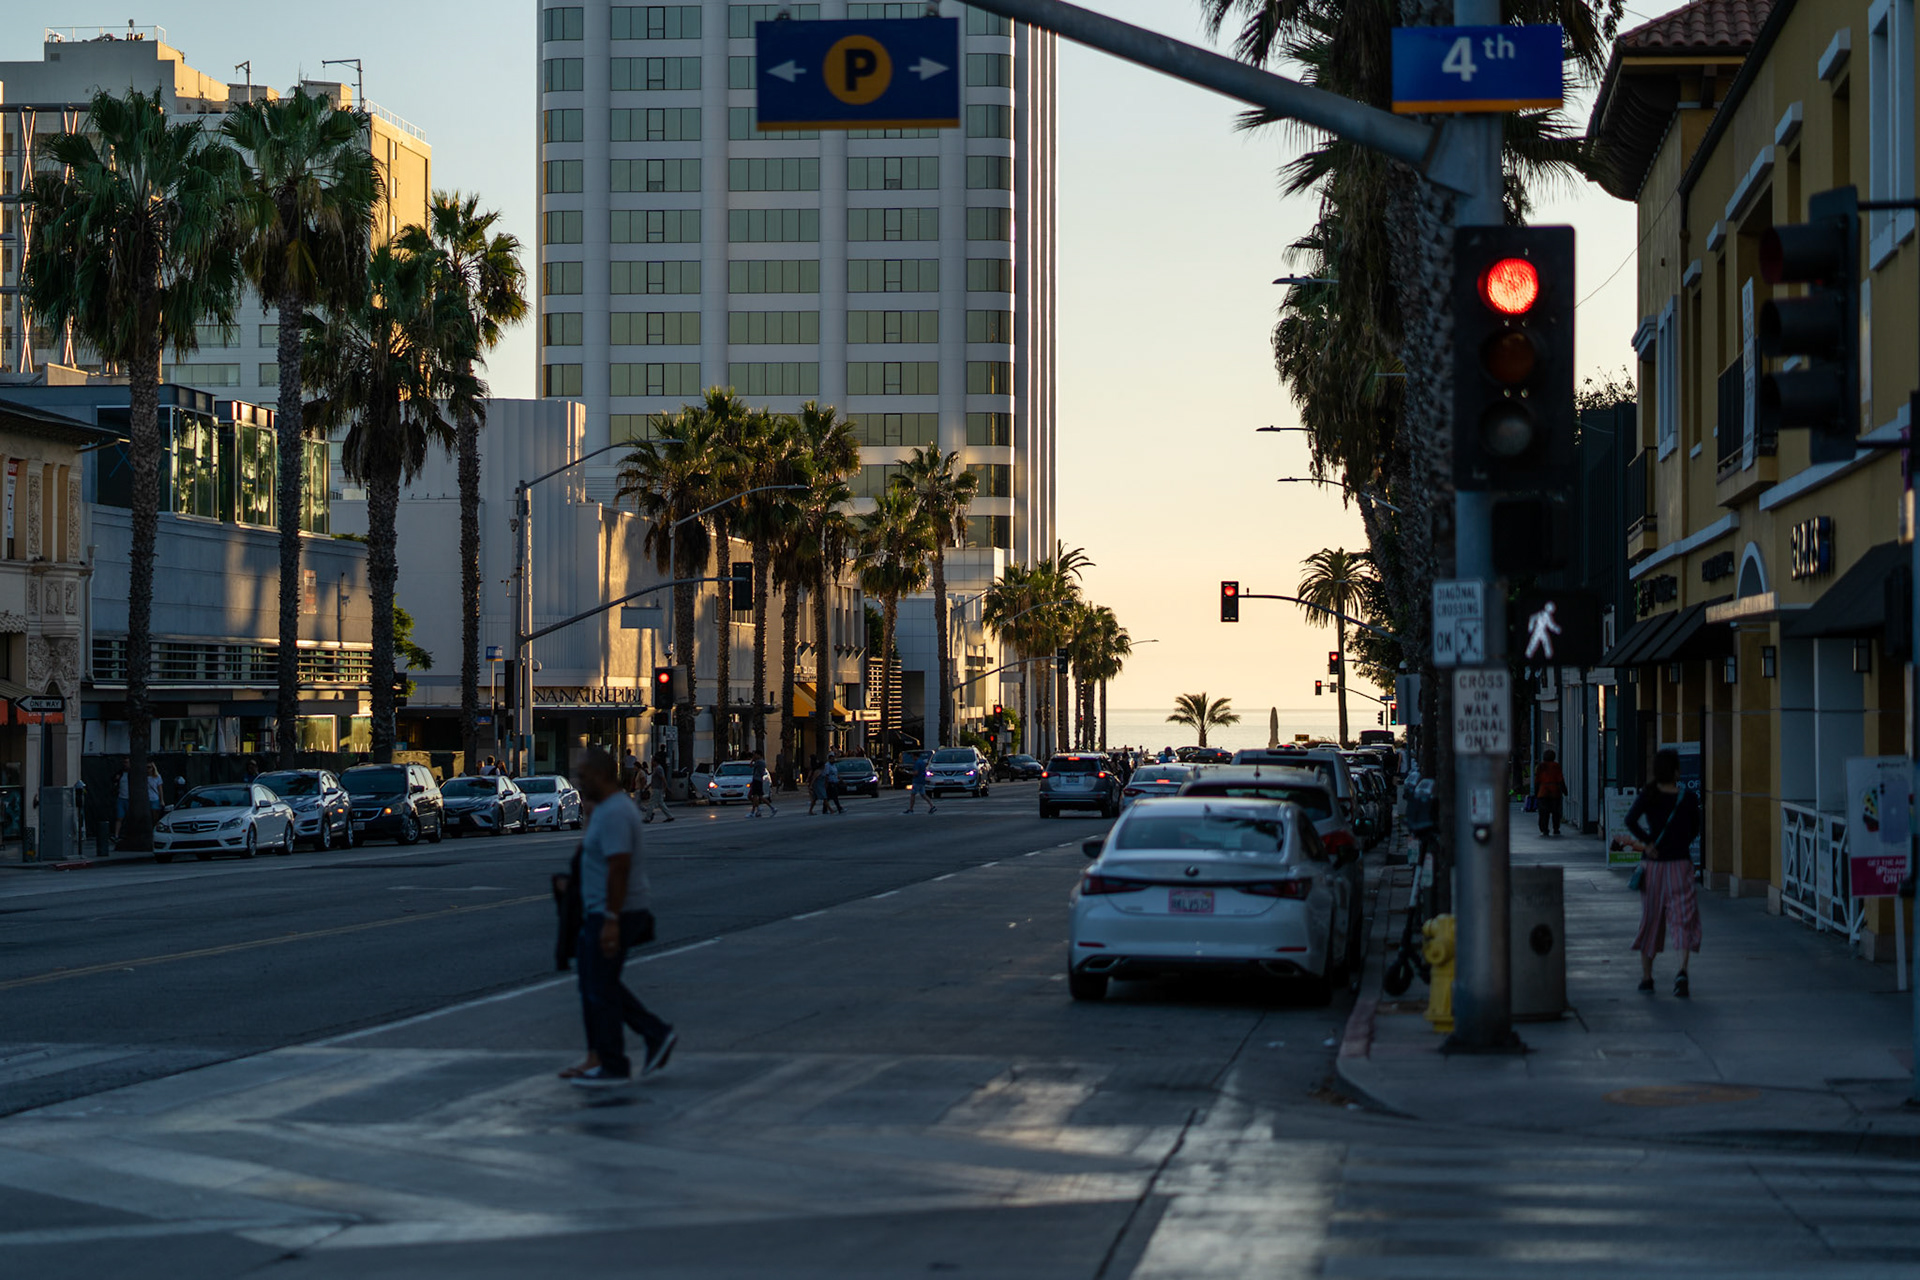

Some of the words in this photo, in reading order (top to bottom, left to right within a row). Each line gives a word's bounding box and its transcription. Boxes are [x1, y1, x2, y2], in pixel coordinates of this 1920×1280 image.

[1442, 33, 1516, 82] 4th
[844, 48, 877, 92] P
[1437, 585, 1476, 600] DIAGONAL
[1436, 602, 1478, 616] CROSSING
[1436, 632, 1452, 652] OK
[1459, 673, 1504, 688] CROSS
[1474, 690, 1489, 701] ON
[29, 700, 43, 708] ONE
[45, 700, 60, 708] WAY
[1463, 702, 1499, 716] WALK
[1457, 718, 1505, 732] SIGNAL
[1465, 734, 1499, 749] ONLY
